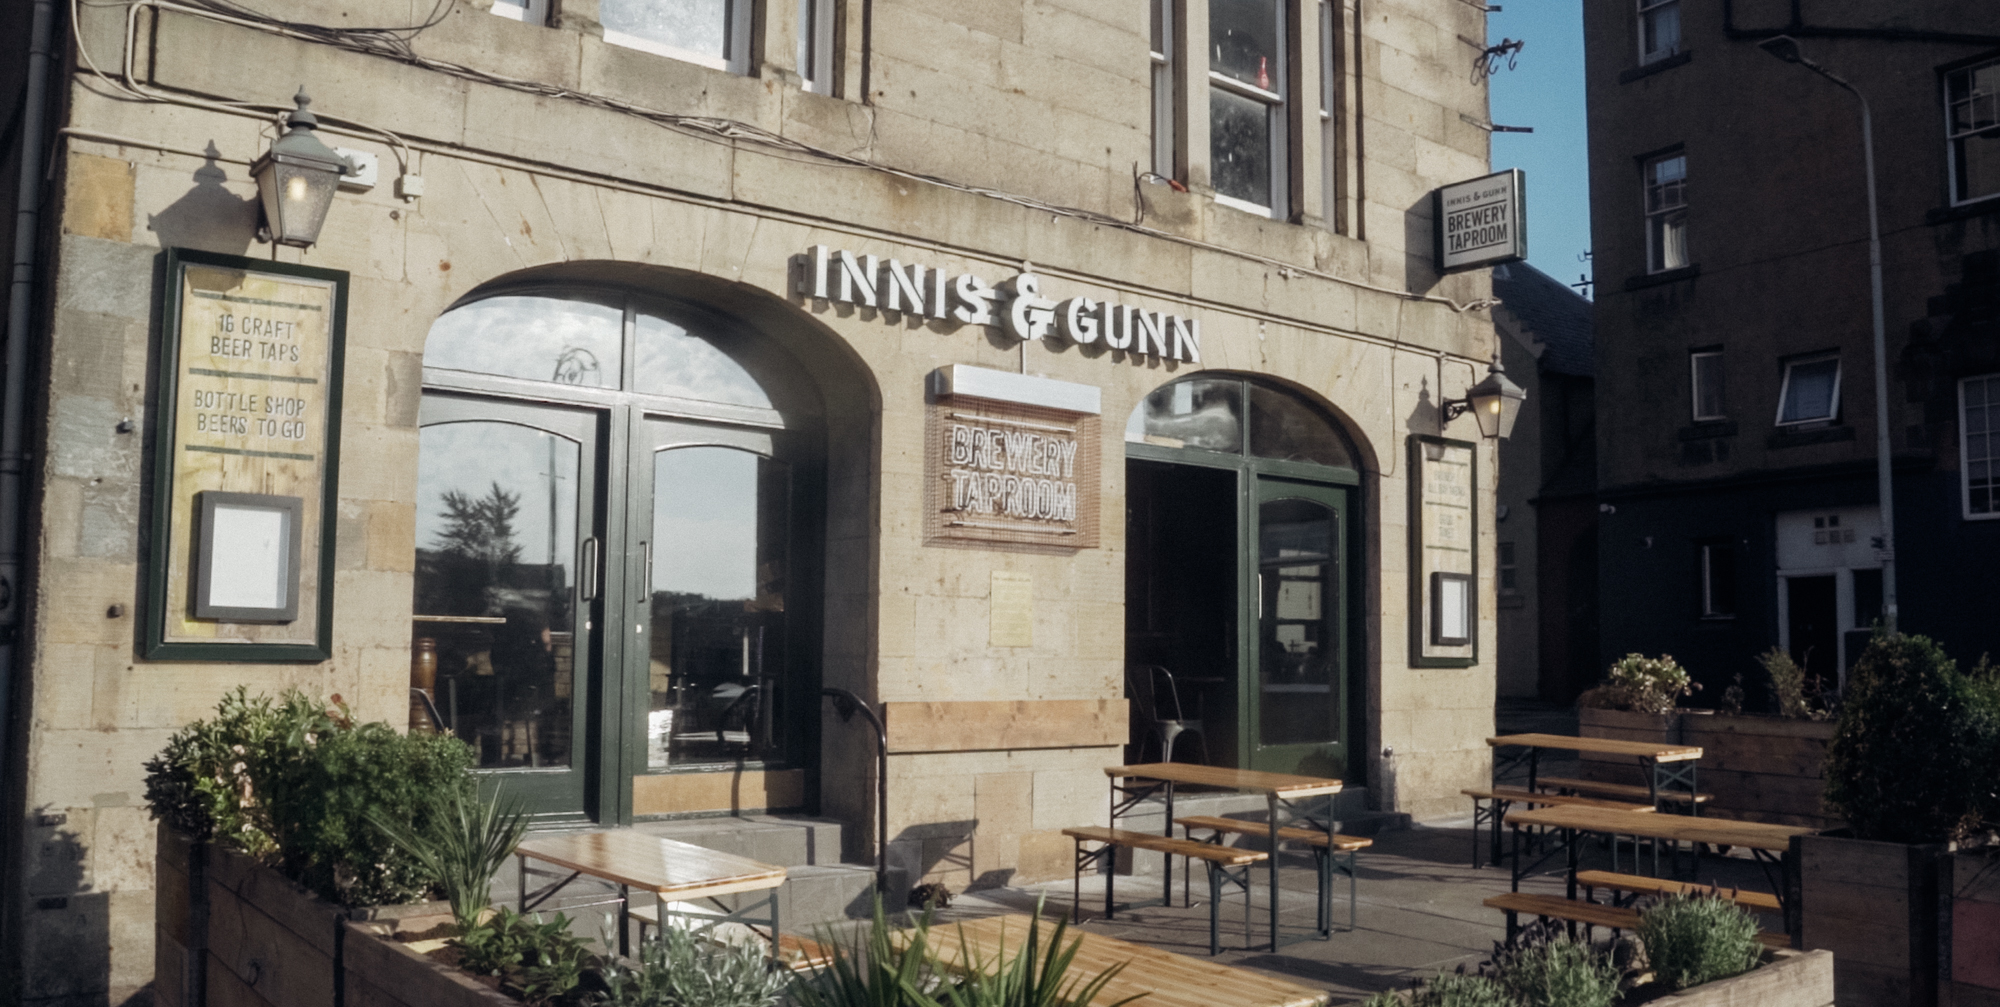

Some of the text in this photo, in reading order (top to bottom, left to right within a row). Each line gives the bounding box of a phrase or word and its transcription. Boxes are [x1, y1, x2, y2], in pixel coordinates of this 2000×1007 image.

[1446, 186, 1507, 207] INNIS & GUNN
[1447, 203, 1507, 233] BREWERY
[1448, 222, 1507, 251] TAPROOM
[808, 244, 1201, 363] INNIS & GUNN
[218, 314, 294, 340] 16 CRAFT
[211, 336, 299, 363] BEER TAPS
[194, 389, 306, 417] BOTTLE SHOP
[197, 413, 305, 440] BEERS TO GO
[951, 424, 1078, 478] BREWERY
[950, 469, 1077, 521] TAPROOM
